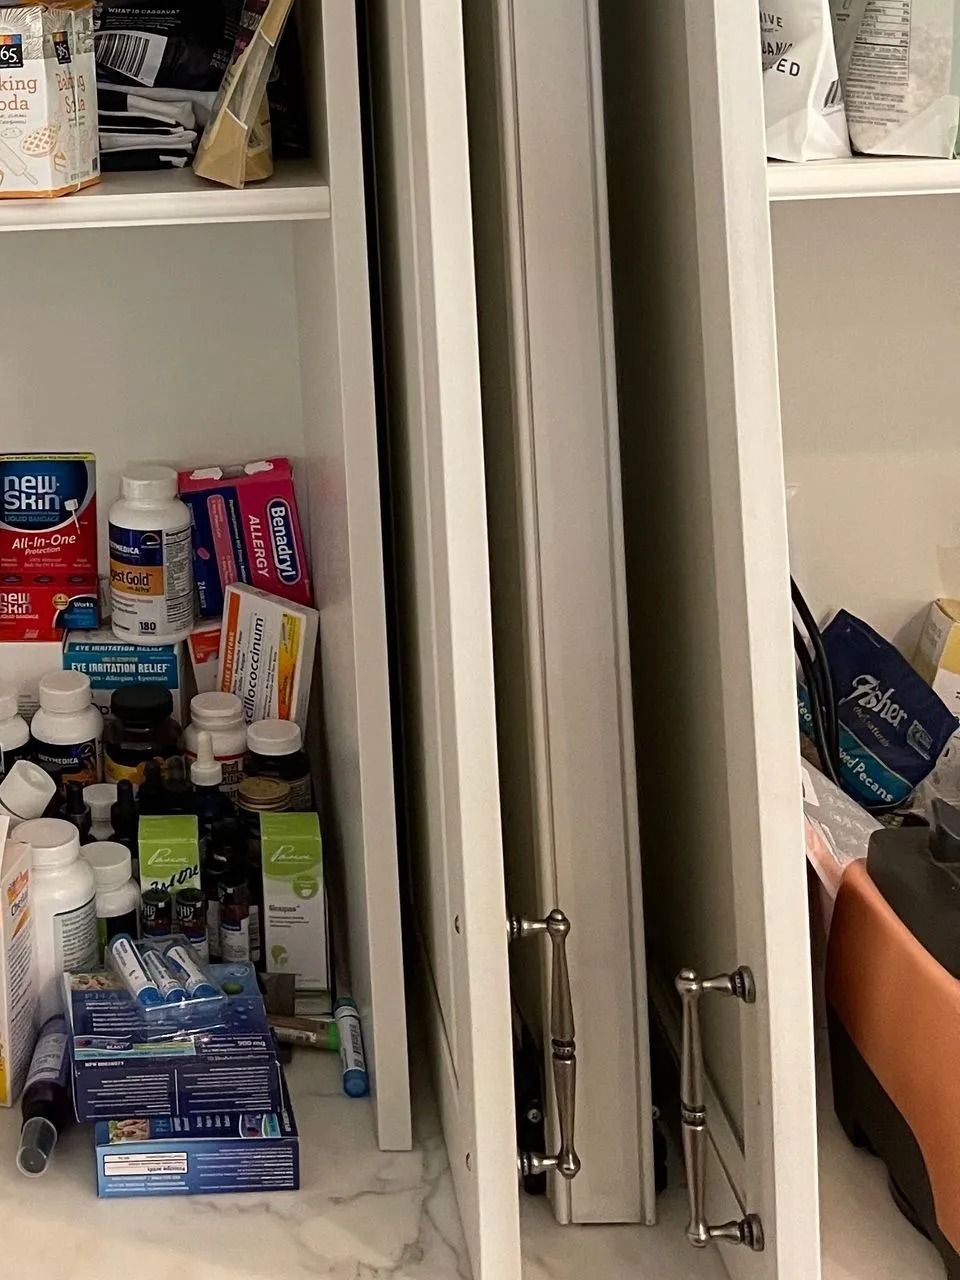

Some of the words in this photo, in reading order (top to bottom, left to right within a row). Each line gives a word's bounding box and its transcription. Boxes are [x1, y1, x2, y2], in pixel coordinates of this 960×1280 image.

[4, 475, 57, 493] new
[4, 492, 61, 510] Skin
[12, 534, 76, 550] All-In-One
[25, 546, 61, 556] Protection
[248, 515, 269, 578] ALLERGY
[270, 506, 297, 581] Benadryl
[126, 572, 149, 587] Gold
[139, 622, 156, 631] 180
[71, 663, 87, 672] EYE
[89, 663, 136, 673] IRRITATION
[138, 663, 168, 673] RELIEF
[244, 617, 264, 725] scillococcinum
[838, 674, 908, 728] Fisher
[853, 761, 894, 803] Pecans
